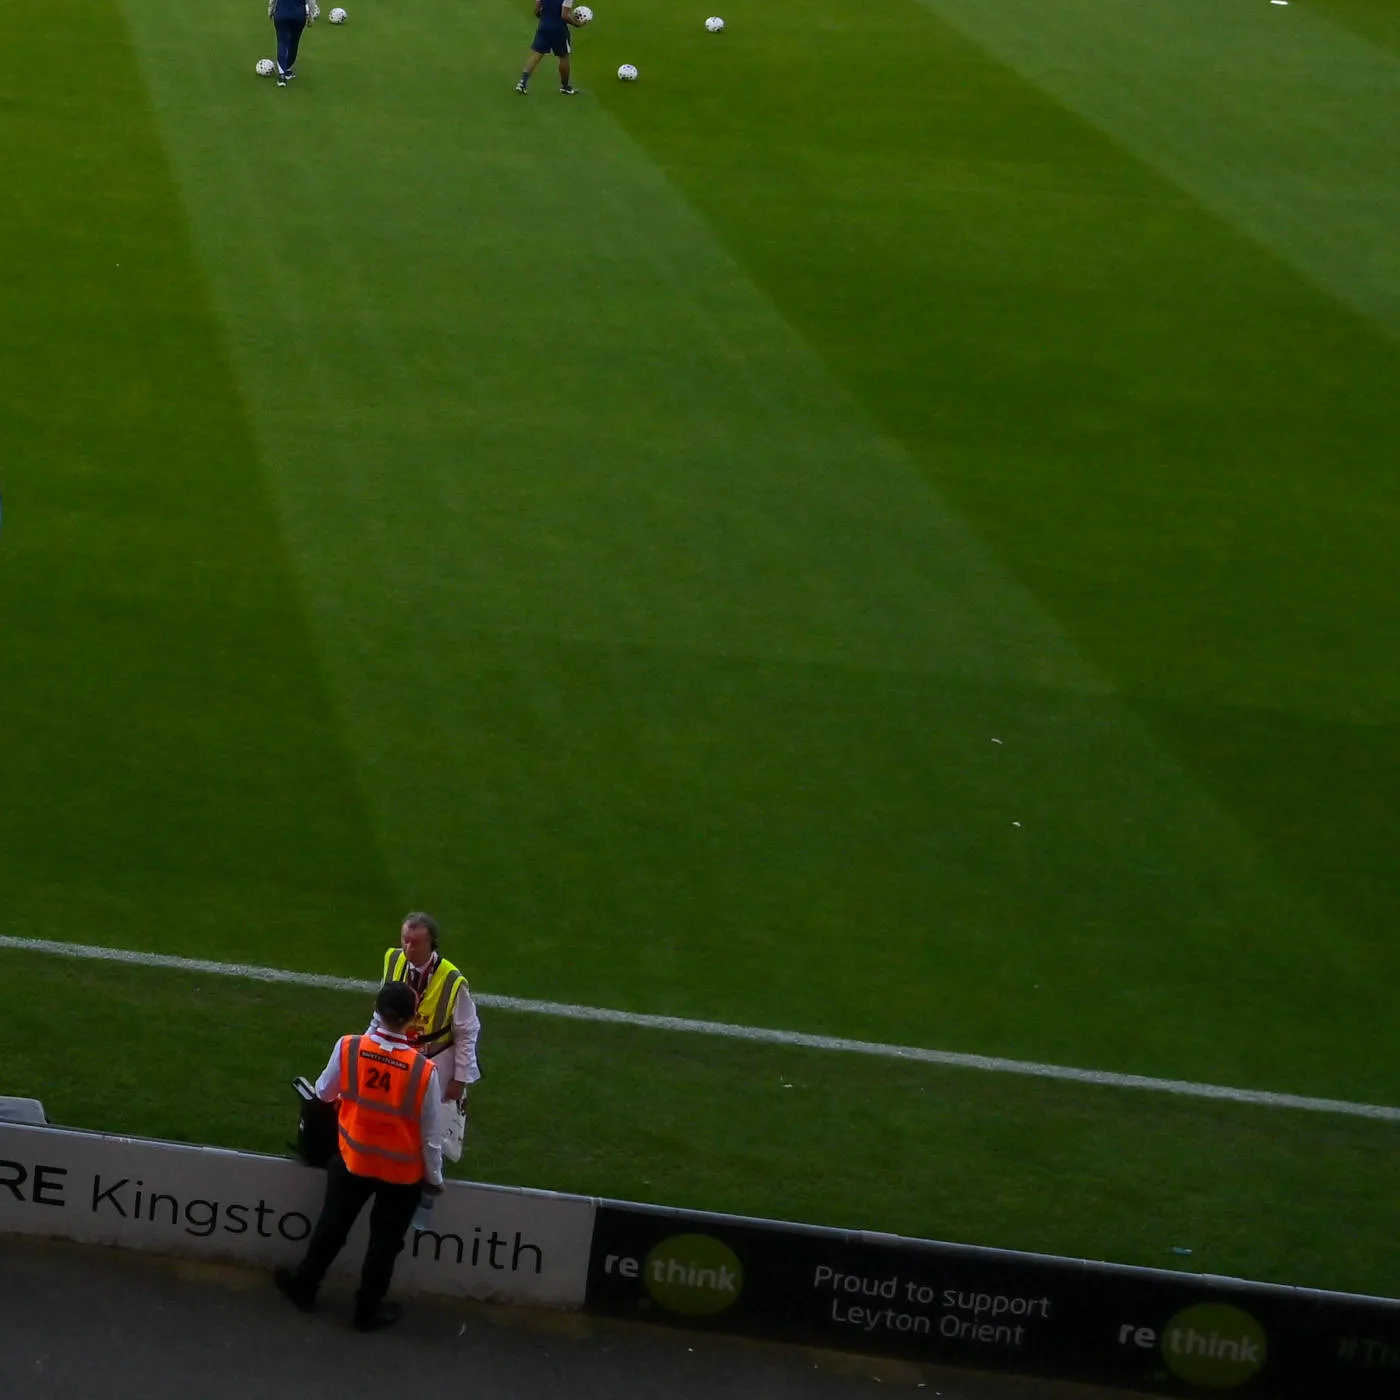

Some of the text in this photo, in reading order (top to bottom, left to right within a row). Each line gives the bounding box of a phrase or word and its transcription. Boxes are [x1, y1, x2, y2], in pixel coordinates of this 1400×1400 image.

[366, 1067, 392, 1092] 24
[604, 1253, 737, 1294] re think
[813, 1265, 1052, 1319] Proud to support
[831, 1298, 1026, 1346] Leyton Orient
[1117, 1321, 1259, 1365] re think
